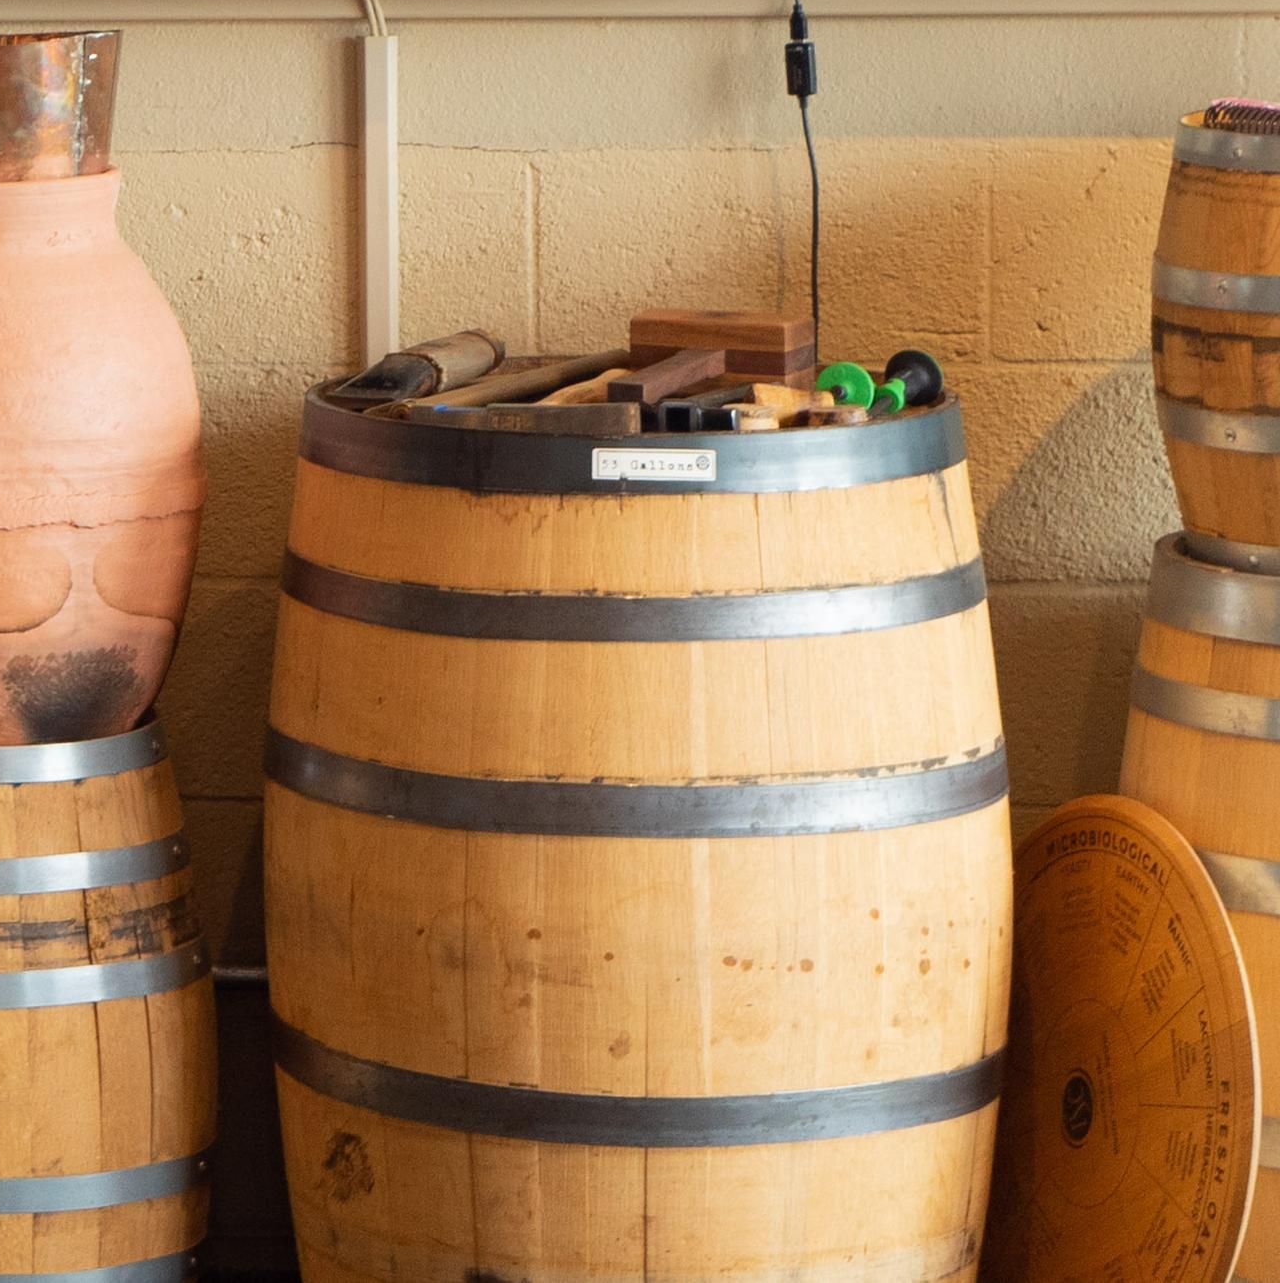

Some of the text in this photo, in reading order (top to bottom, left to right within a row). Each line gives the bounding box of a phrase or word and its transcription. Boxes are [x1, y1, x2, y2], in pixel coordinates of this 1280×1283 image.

[602, 459, 693, 471] 53 Gallons
[1046, 830, 1164, 886] MICROBIOLOGICAL
[1194, 1080, 1231, 1256] FRESH OAK
